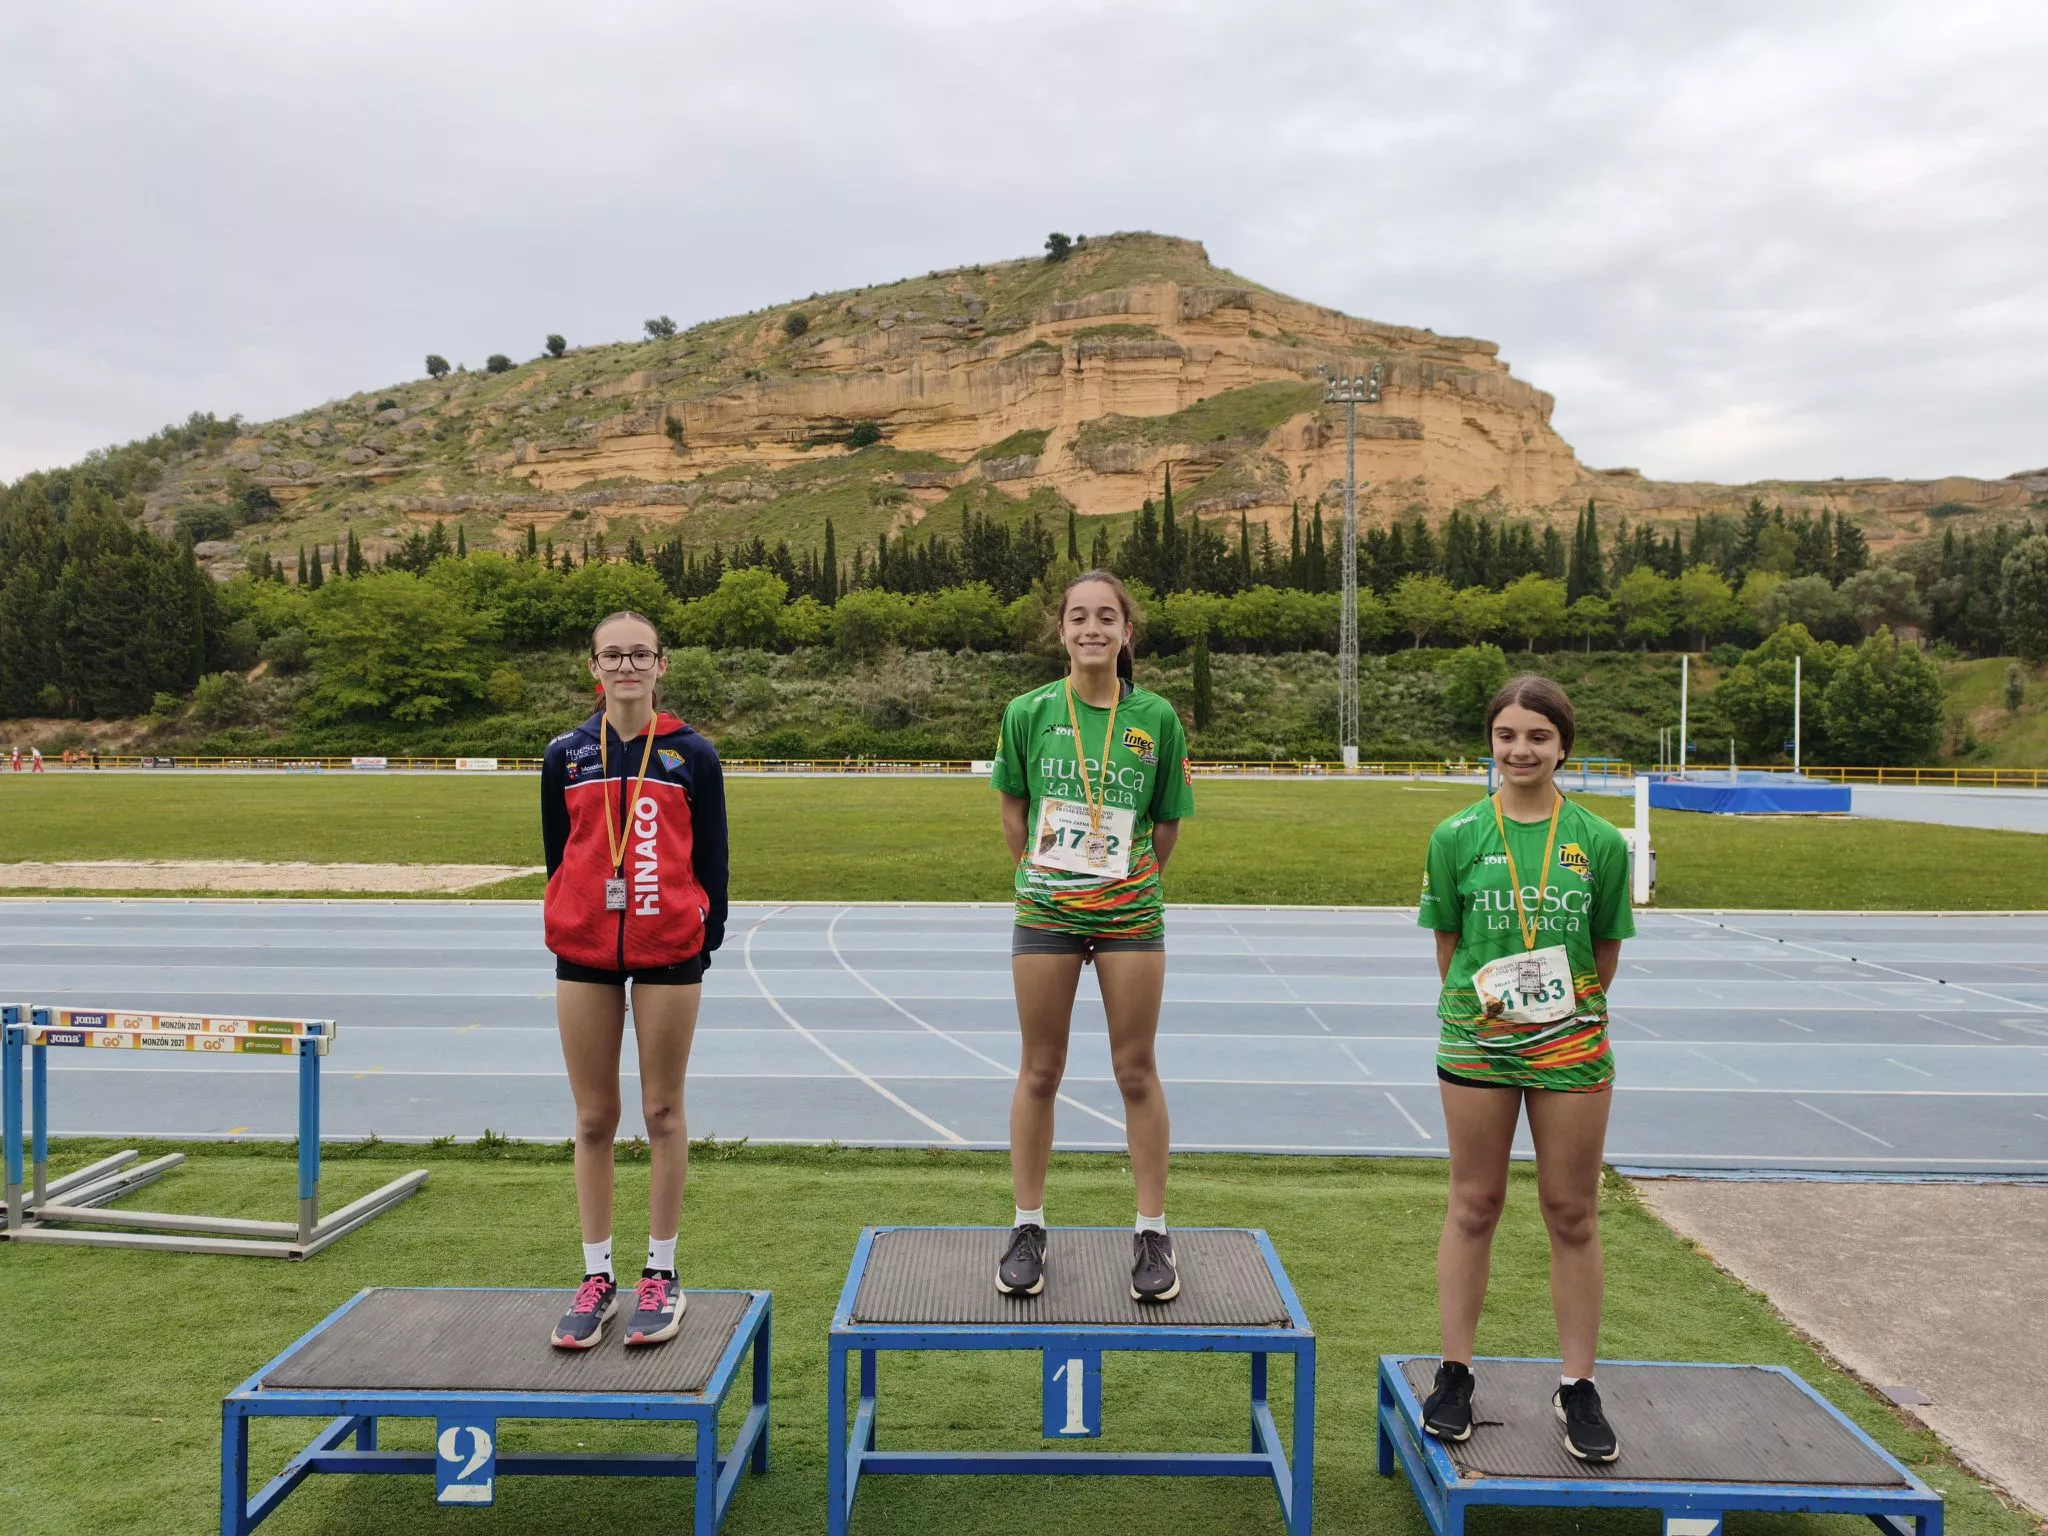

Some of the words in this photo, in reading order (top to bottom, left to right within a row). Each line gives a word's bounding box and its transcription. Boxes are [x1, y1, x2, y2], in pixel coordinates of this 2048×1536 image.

[1040, 757, 1145, 793] Huesca
[1047, 782, 1069, 797] La
[1055, 826, 1119, 856] 172
[634, 796, 660, 916] HINACO
[1473, 885, 1592, 914] Huesca
[1487, 914, 1510, 930] La
[123, 1019, 140, 1029] GO
[160, 1020, 186, 1030] MONZÓN
[187, 1022, 201, 1031] 2021
[218, 1024, 235, 1033] GO
[102, 1037, 120, 1047] GO
[142, 1036, 169, 1046] MONZÓN
[170, 1038, 185, 1047] 2021
[203, 1040, 222, 1050] GO
[1052, 1358, 1090, 1434] 1
[437, 1426, 493, 1502] 2
